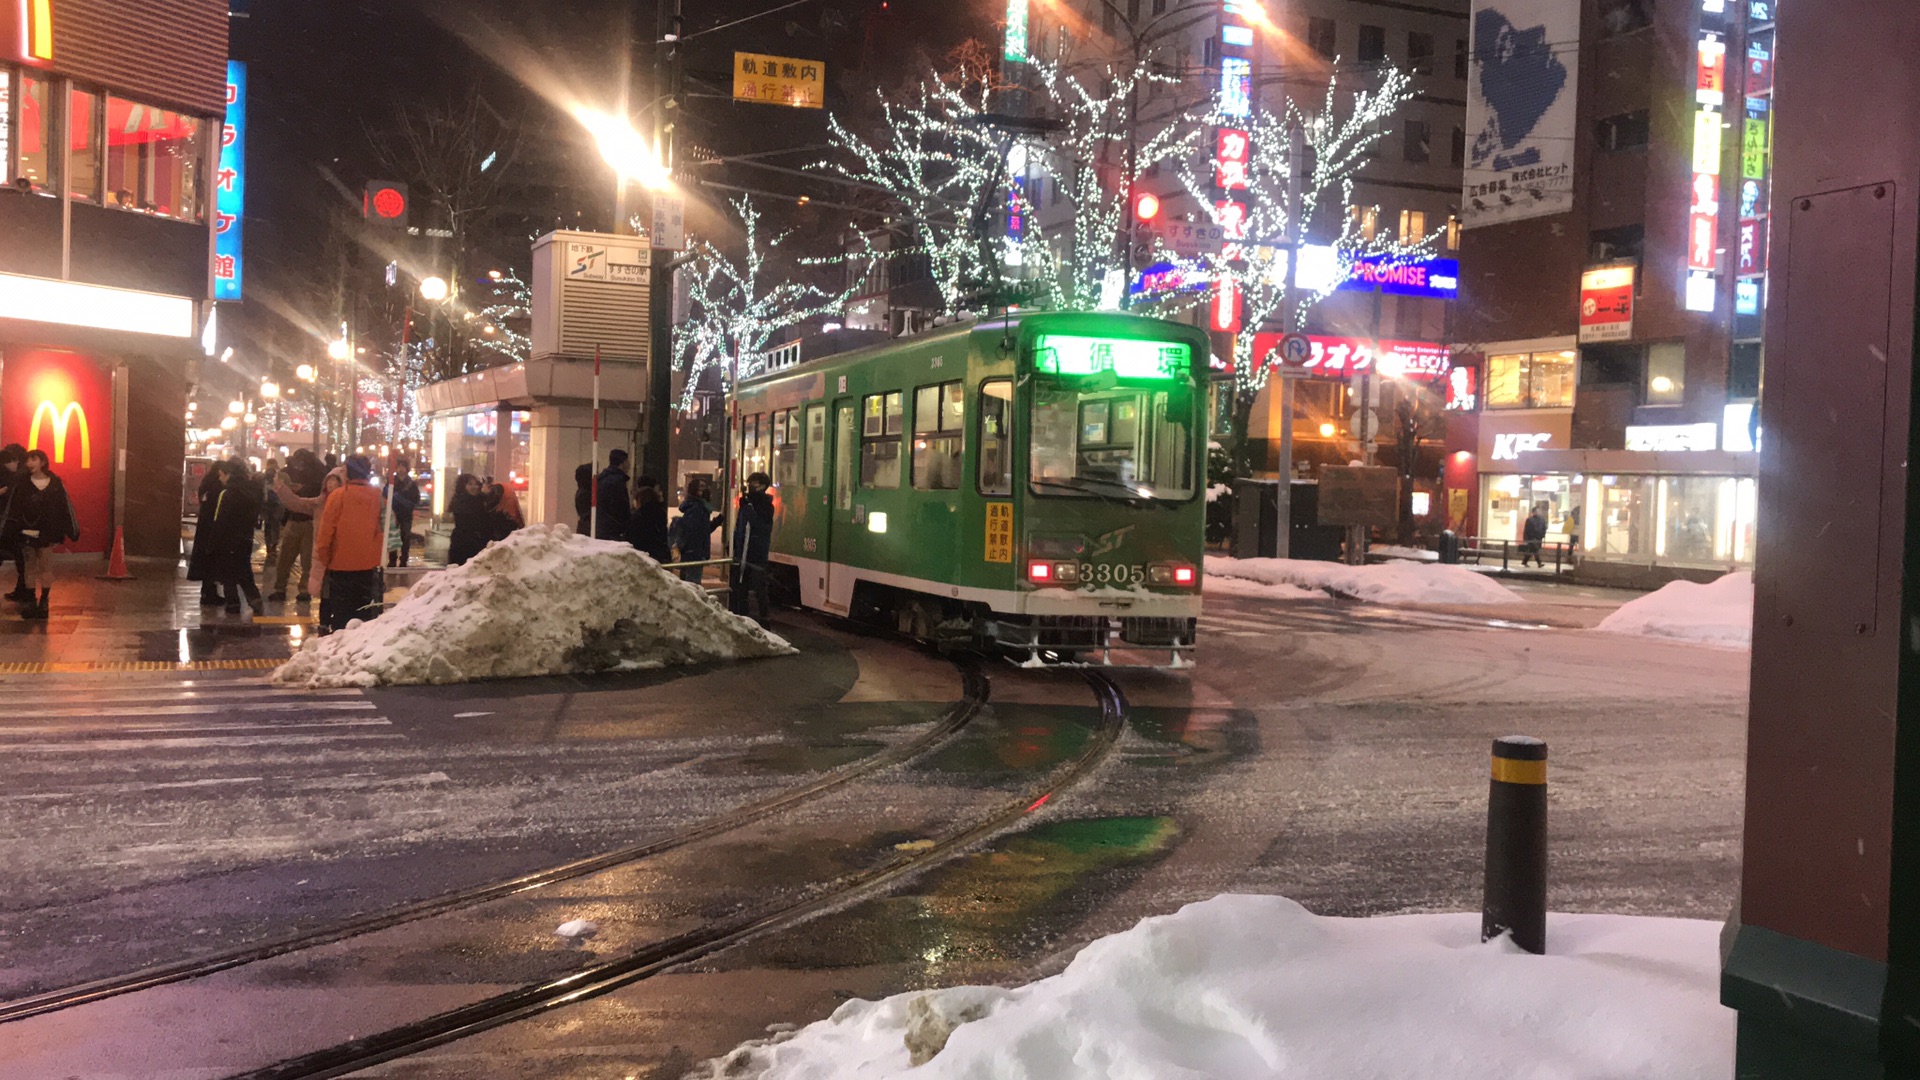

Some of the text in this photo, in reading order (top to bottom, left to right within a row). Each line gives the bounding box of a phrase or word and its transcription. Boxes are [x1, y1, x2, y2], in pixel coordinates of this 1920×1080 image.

[742, 58, 817, 82] 軌道敷内
[742, 80, 815, 103] 通行禁止
[1168, 225, 1221, 240] すすきの
[571, 244, 594, 253] 地下鉄
[1354, 260, 1426, 287] PROMISE
[1491, 433, 1551, 461] KFC
[1080, 563, 1145, 584] 3305
